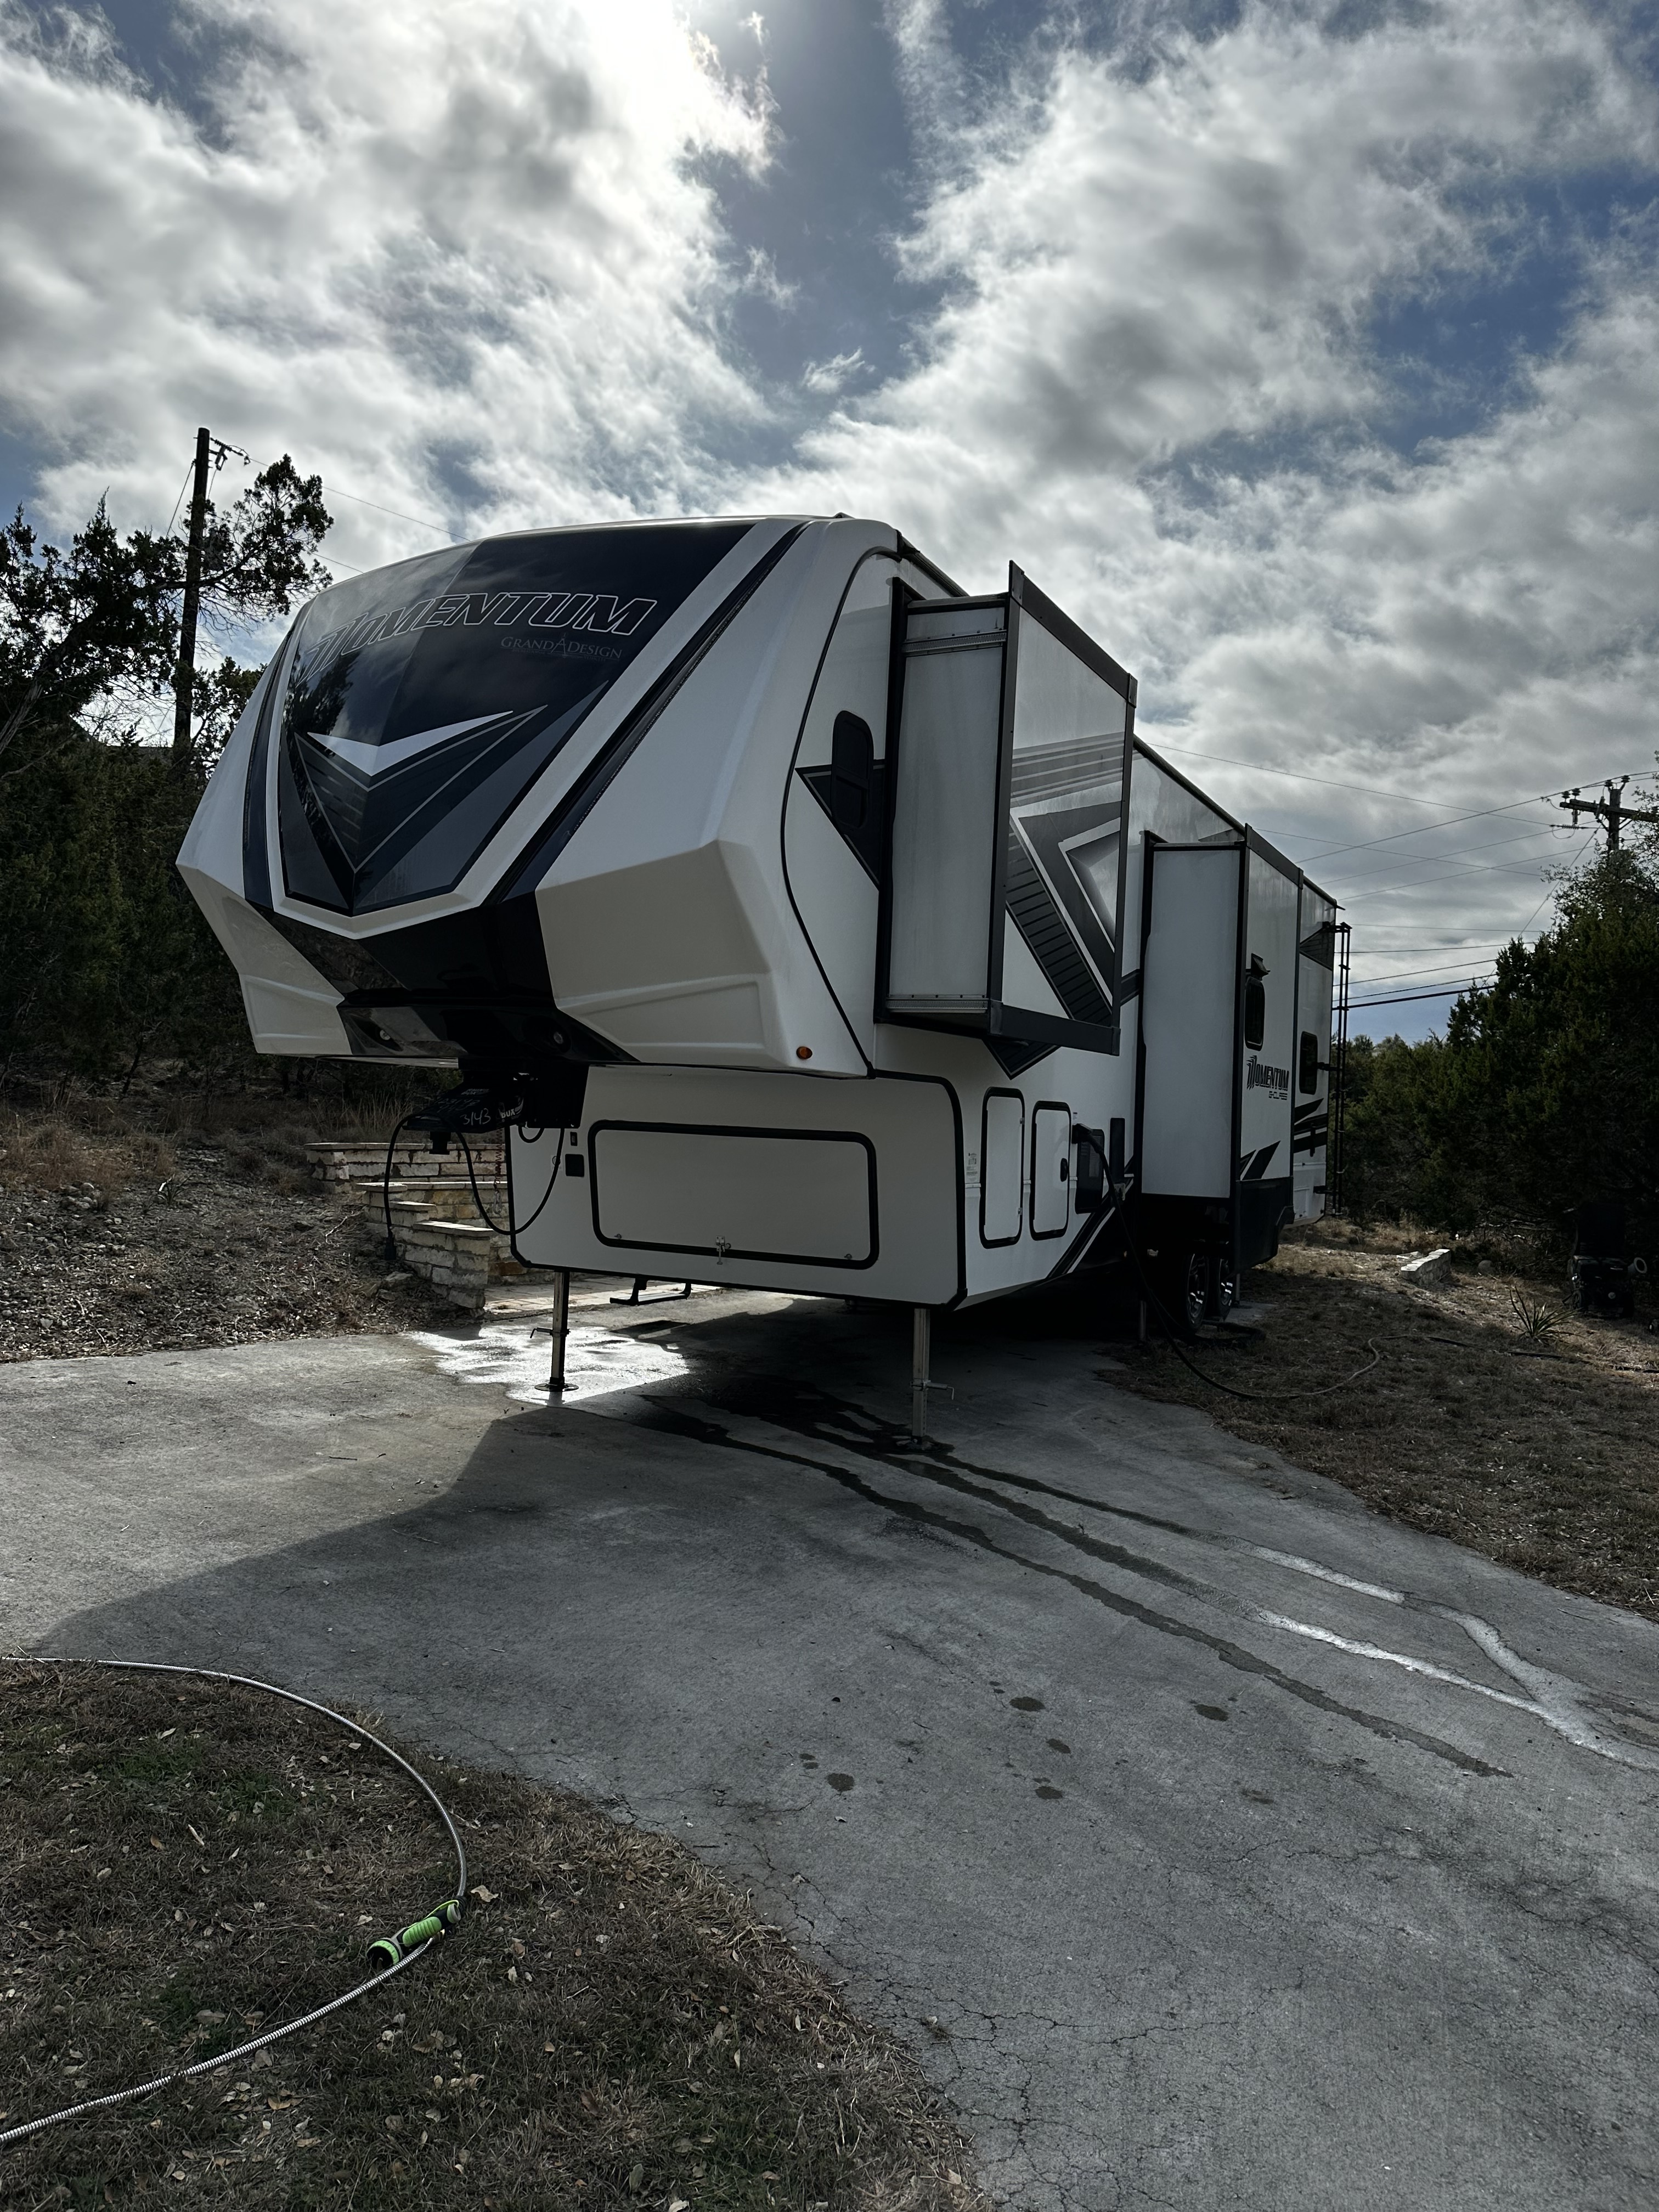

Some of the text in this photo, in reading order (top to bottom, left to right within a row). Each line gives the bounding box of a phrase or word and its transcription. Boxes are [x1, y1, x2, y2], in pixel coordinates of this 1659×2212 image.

[296, 592, 658, 688] MOMENTUM
[499, 635, 554, 651] GRAND
[567, 641, 623, 659] DESIGN
[1246, 1055, 1289, 1091] MOMENTUM
[460, 1108, 492, 1126] 3143
